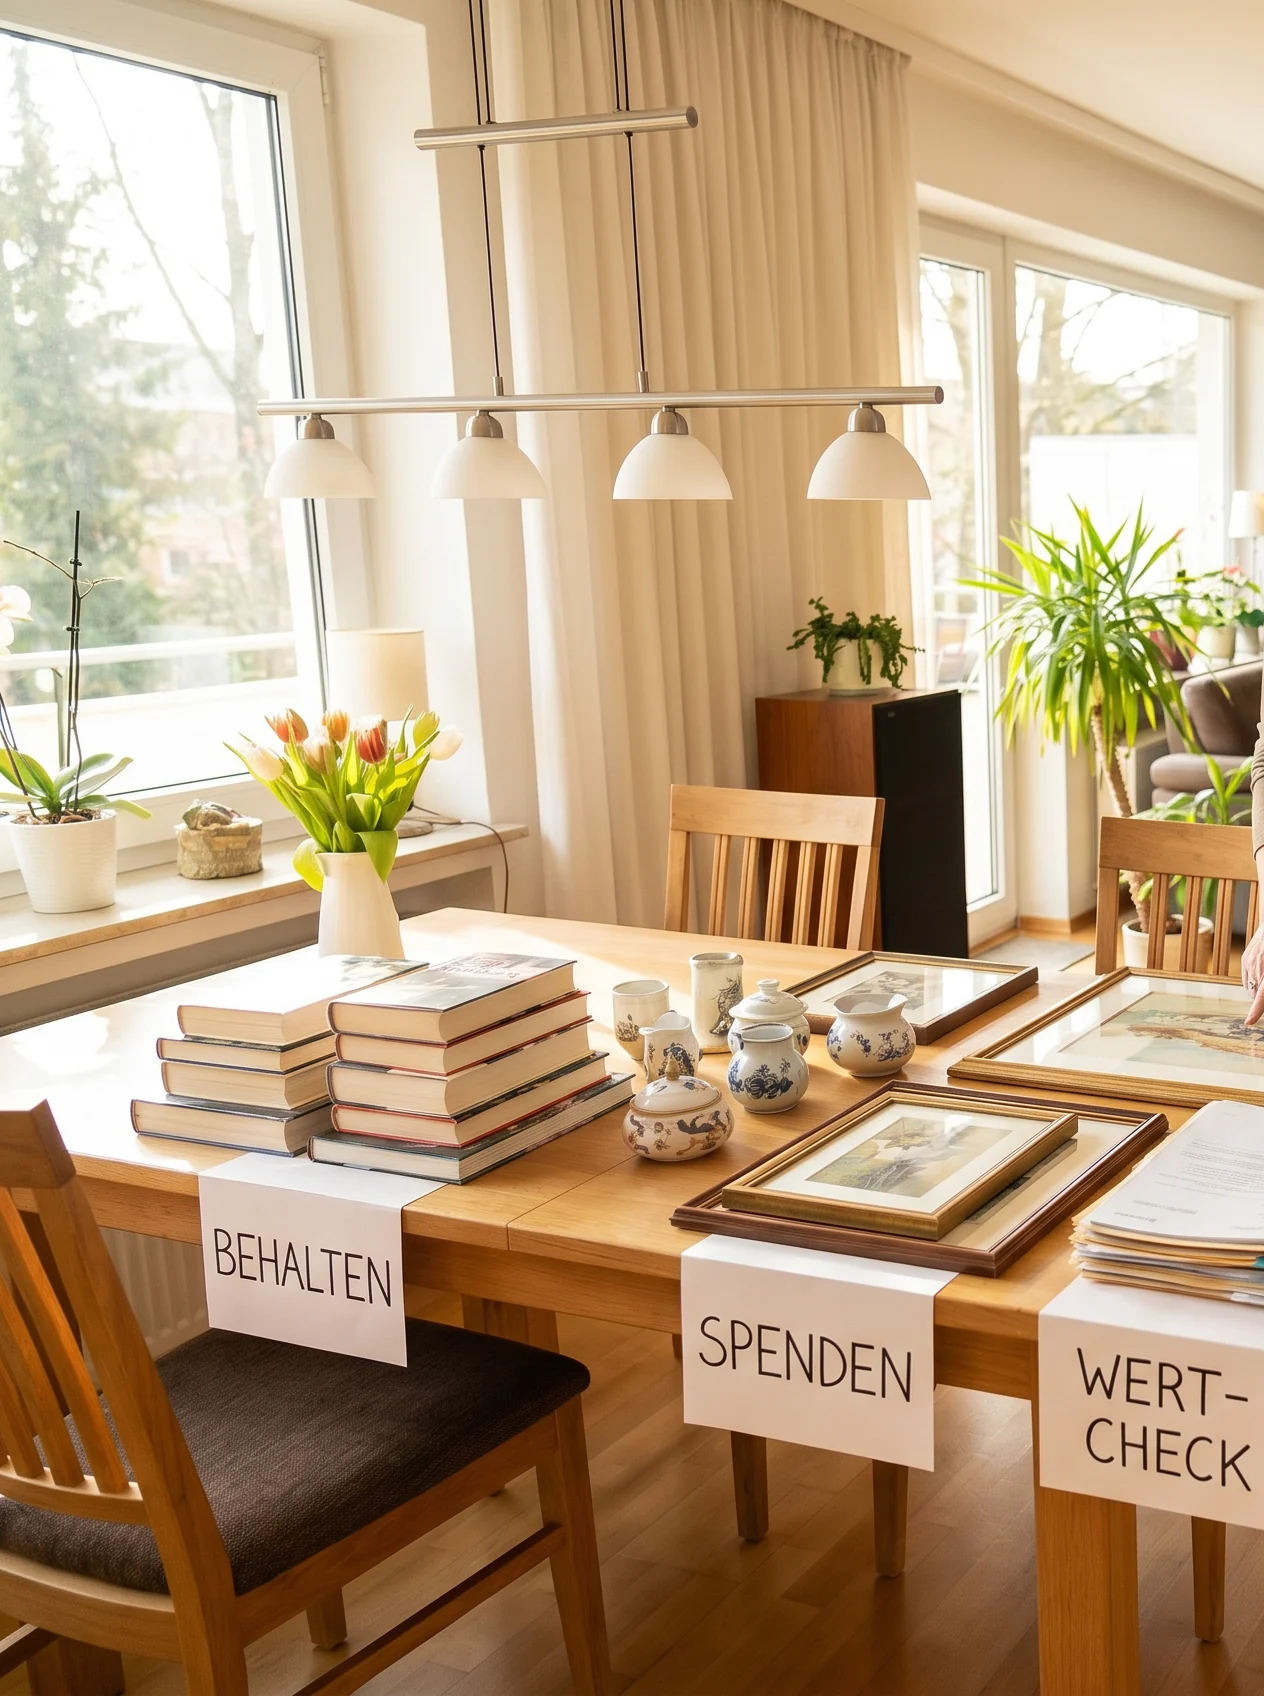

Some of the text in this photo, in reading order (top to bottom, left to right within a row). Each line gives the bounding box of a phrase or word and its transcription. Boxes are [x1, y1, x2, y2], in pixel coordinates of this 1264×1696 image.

[213, 1228, 391, 1307] BEHALTEN
[699, 1316, 911, 1403] SPENDEN
[1077, 1347, 1248, 1416] WERT-
[1086, 1417, 1251, 1492] CHECK
